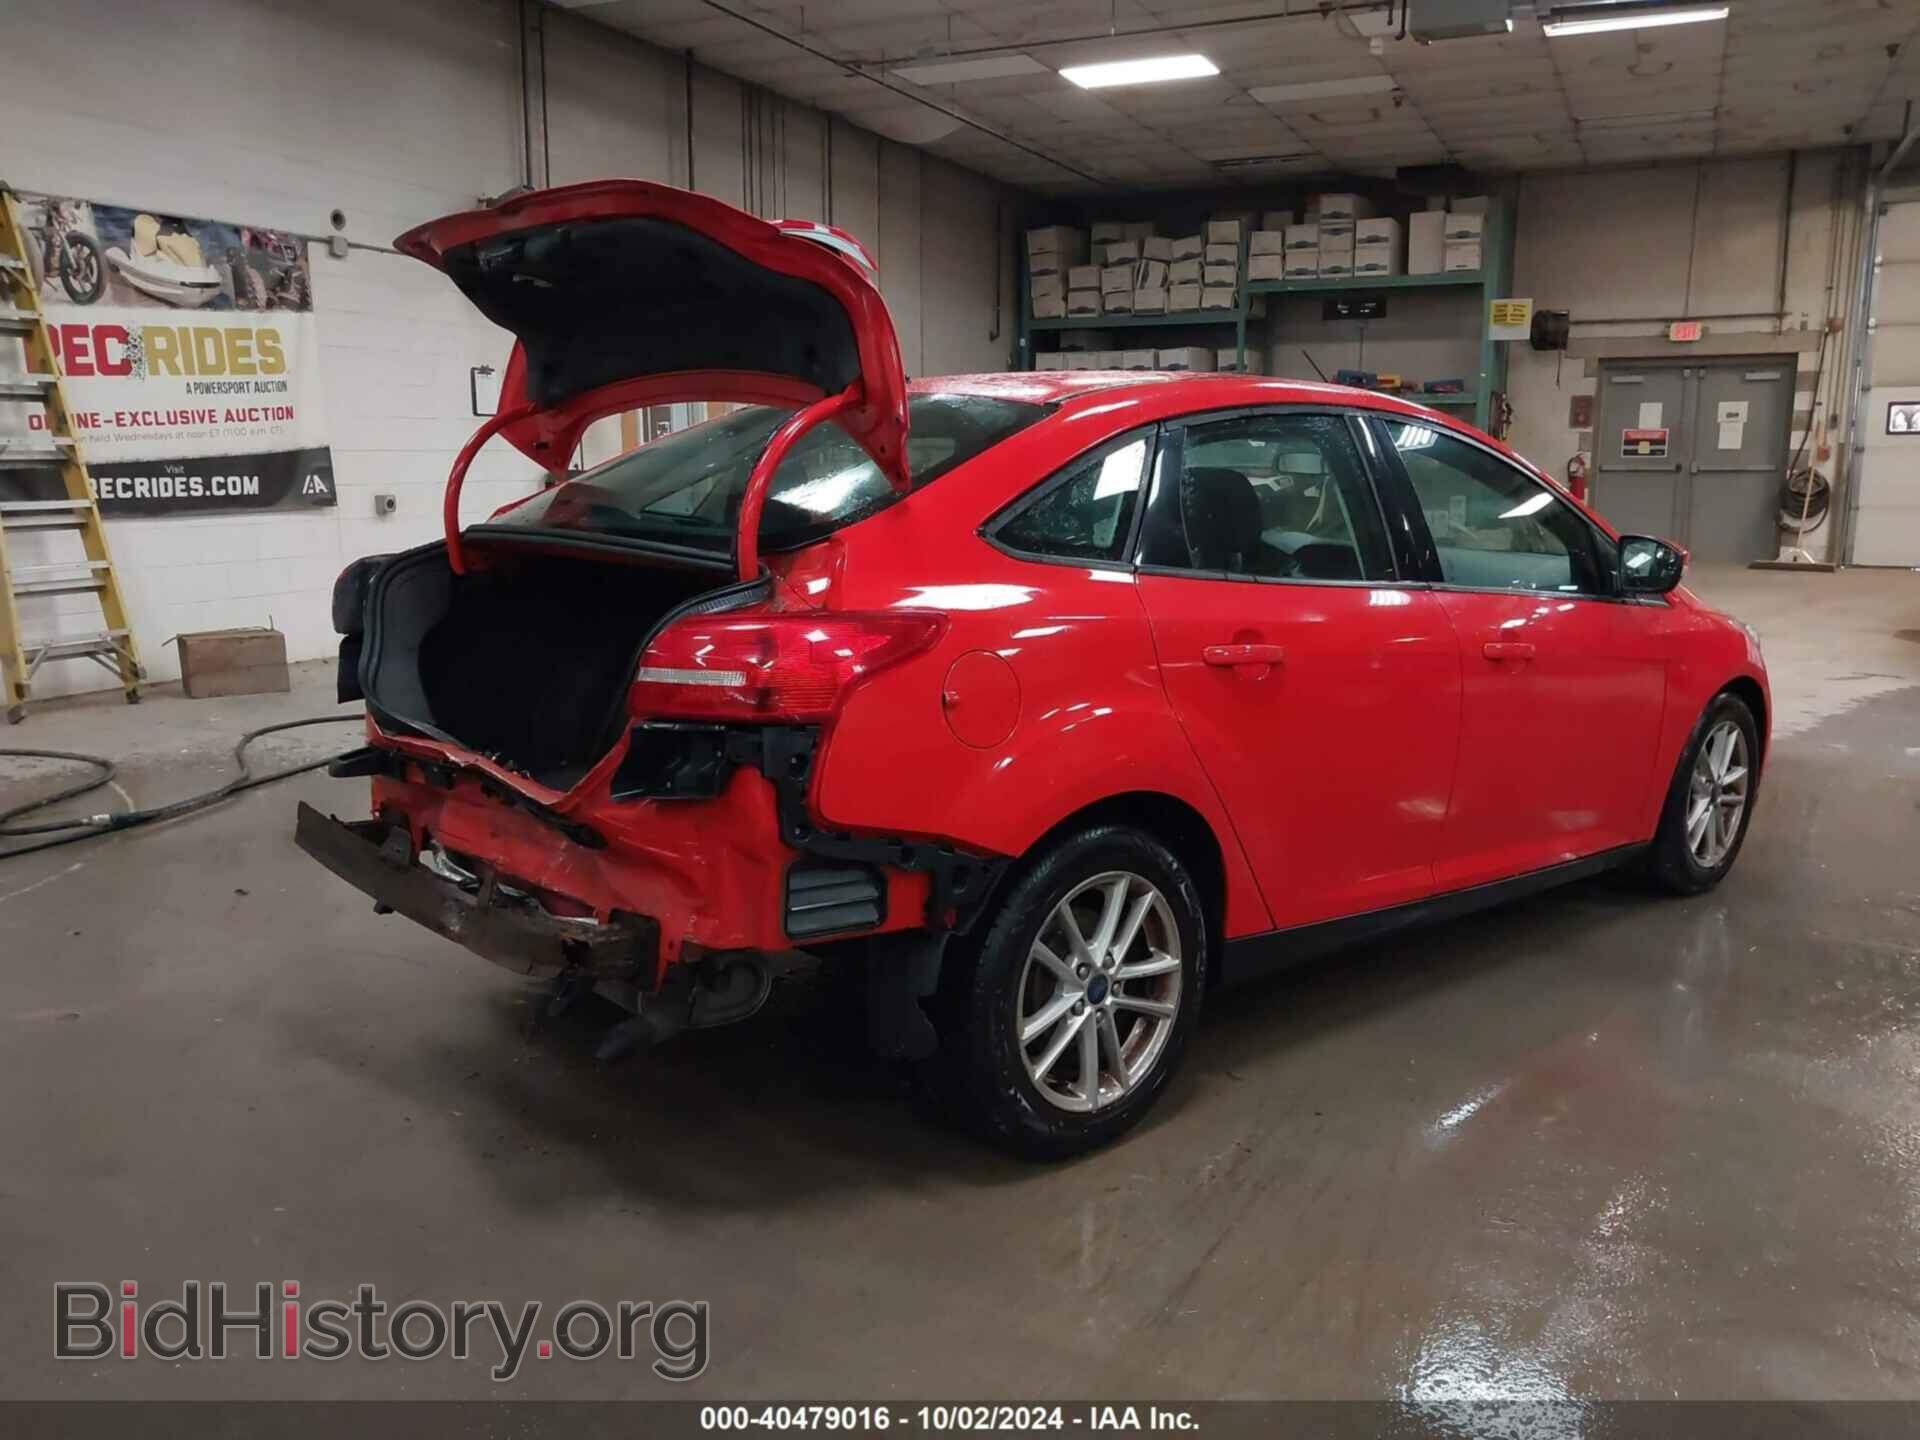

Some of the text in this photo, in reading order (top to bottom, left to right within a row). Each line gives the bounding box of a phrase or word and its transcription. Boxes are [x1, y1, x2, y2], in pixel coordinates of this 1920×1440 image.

[143, 325, 288, 377] RIDES
[186, 380, 288, 395] A POWERSPORT AUCTION
[224, 405, 294, 423] AUCTION
[164, 464, 185, 475] Visit
